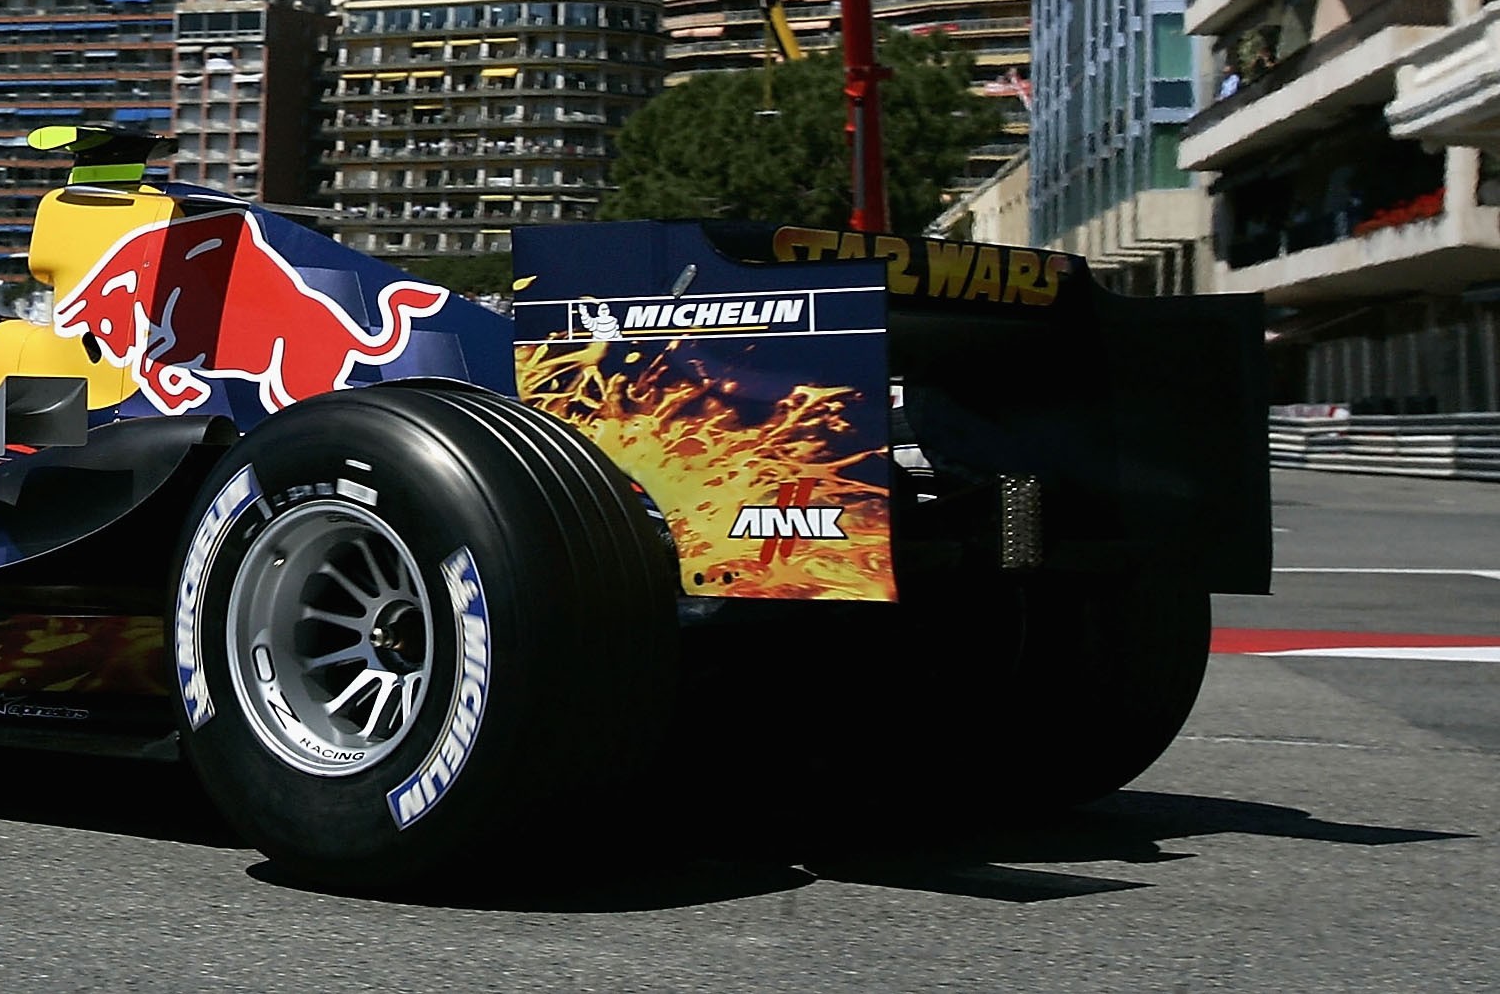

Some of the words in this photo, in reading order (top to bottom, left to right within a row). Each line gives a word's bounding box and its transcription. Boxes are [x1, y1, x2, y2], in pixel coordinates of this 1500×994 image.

[925, 240, 1072, 306] WARS
[623, 298, 805, 329] MICHELIN
[176, 469, 251, 668] MICHELIN
[299, 736, 366, 763] RACING
[398, 613, 488, 825] MICHELIN
